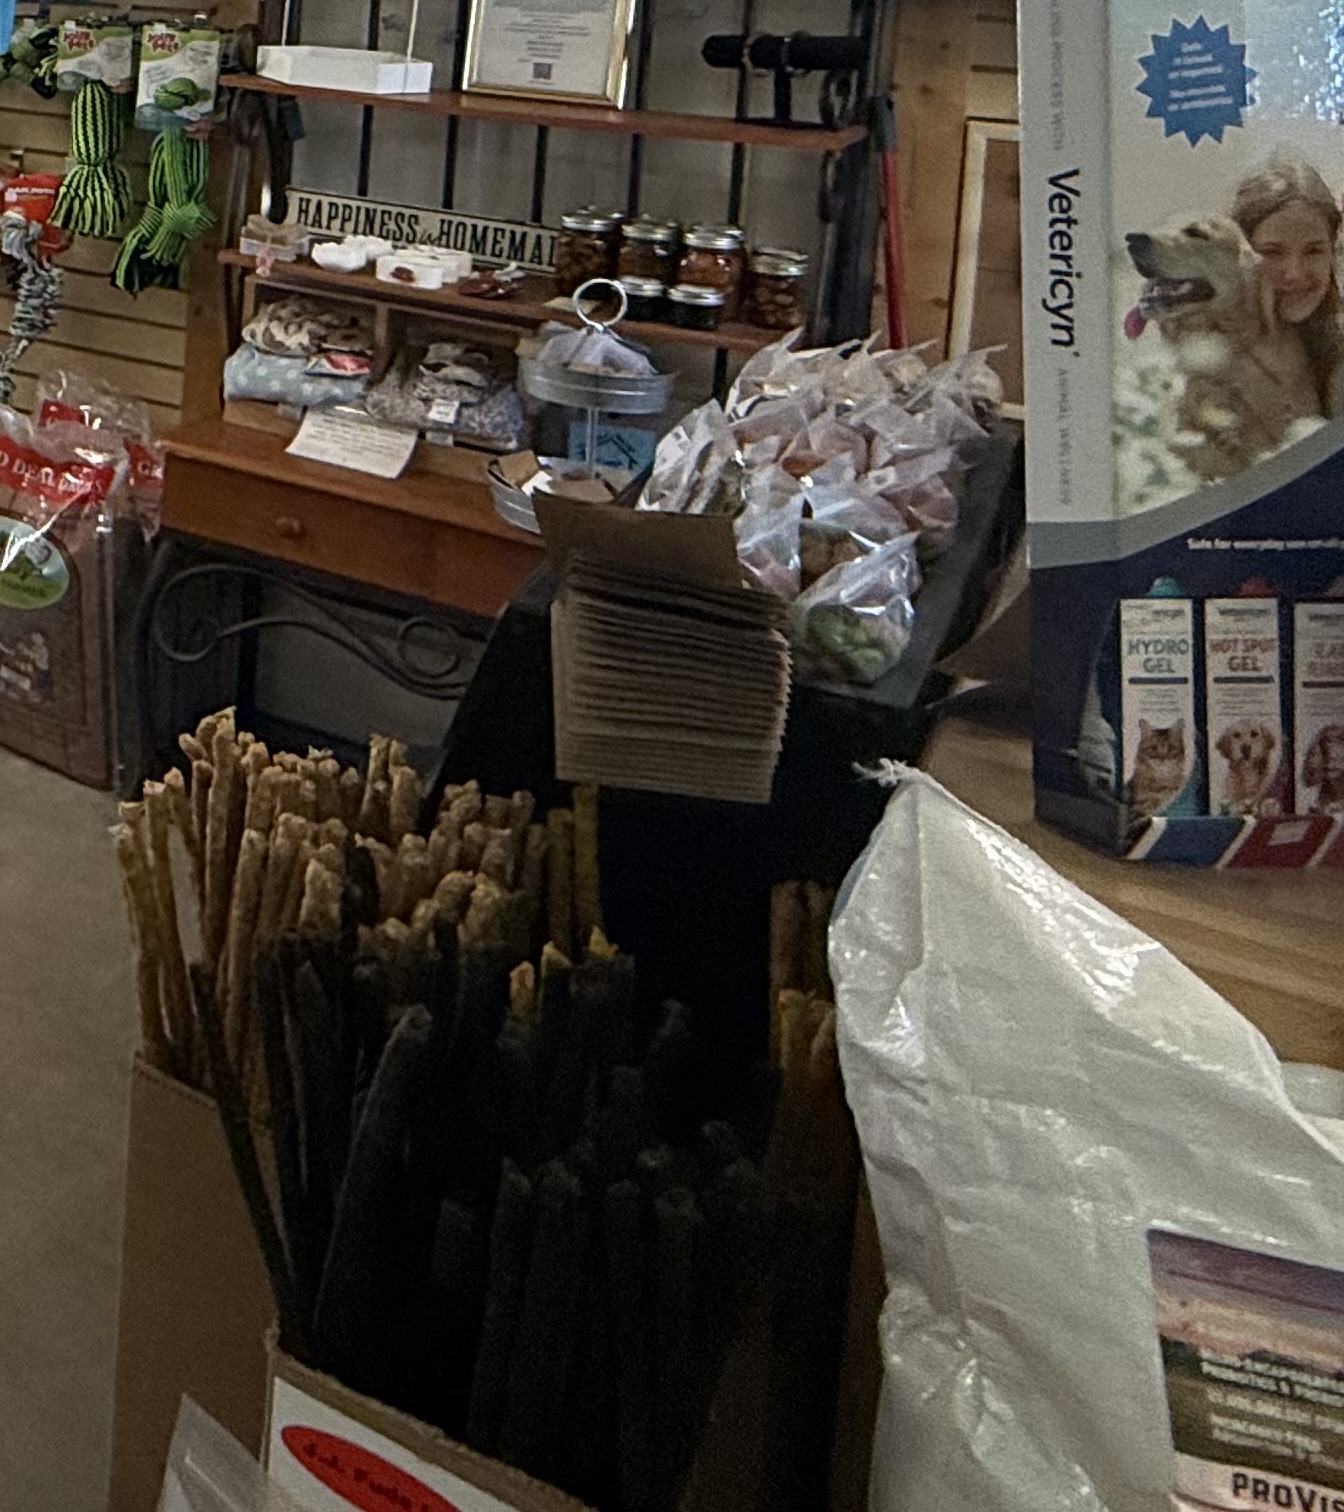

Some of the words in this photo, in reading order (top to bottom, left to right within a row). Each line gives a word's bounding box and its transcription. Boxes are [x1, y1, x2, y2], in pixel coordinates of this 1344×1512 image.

[297, 196, 420, 245] HAPPINESS
[1041, 168, 1081, 348] Vetericyn
[1127, 639, 1190, 656] HYDRO
[1143, 657, 1176, 674] GEL
[1228, 656, 1262, 673] GEL
